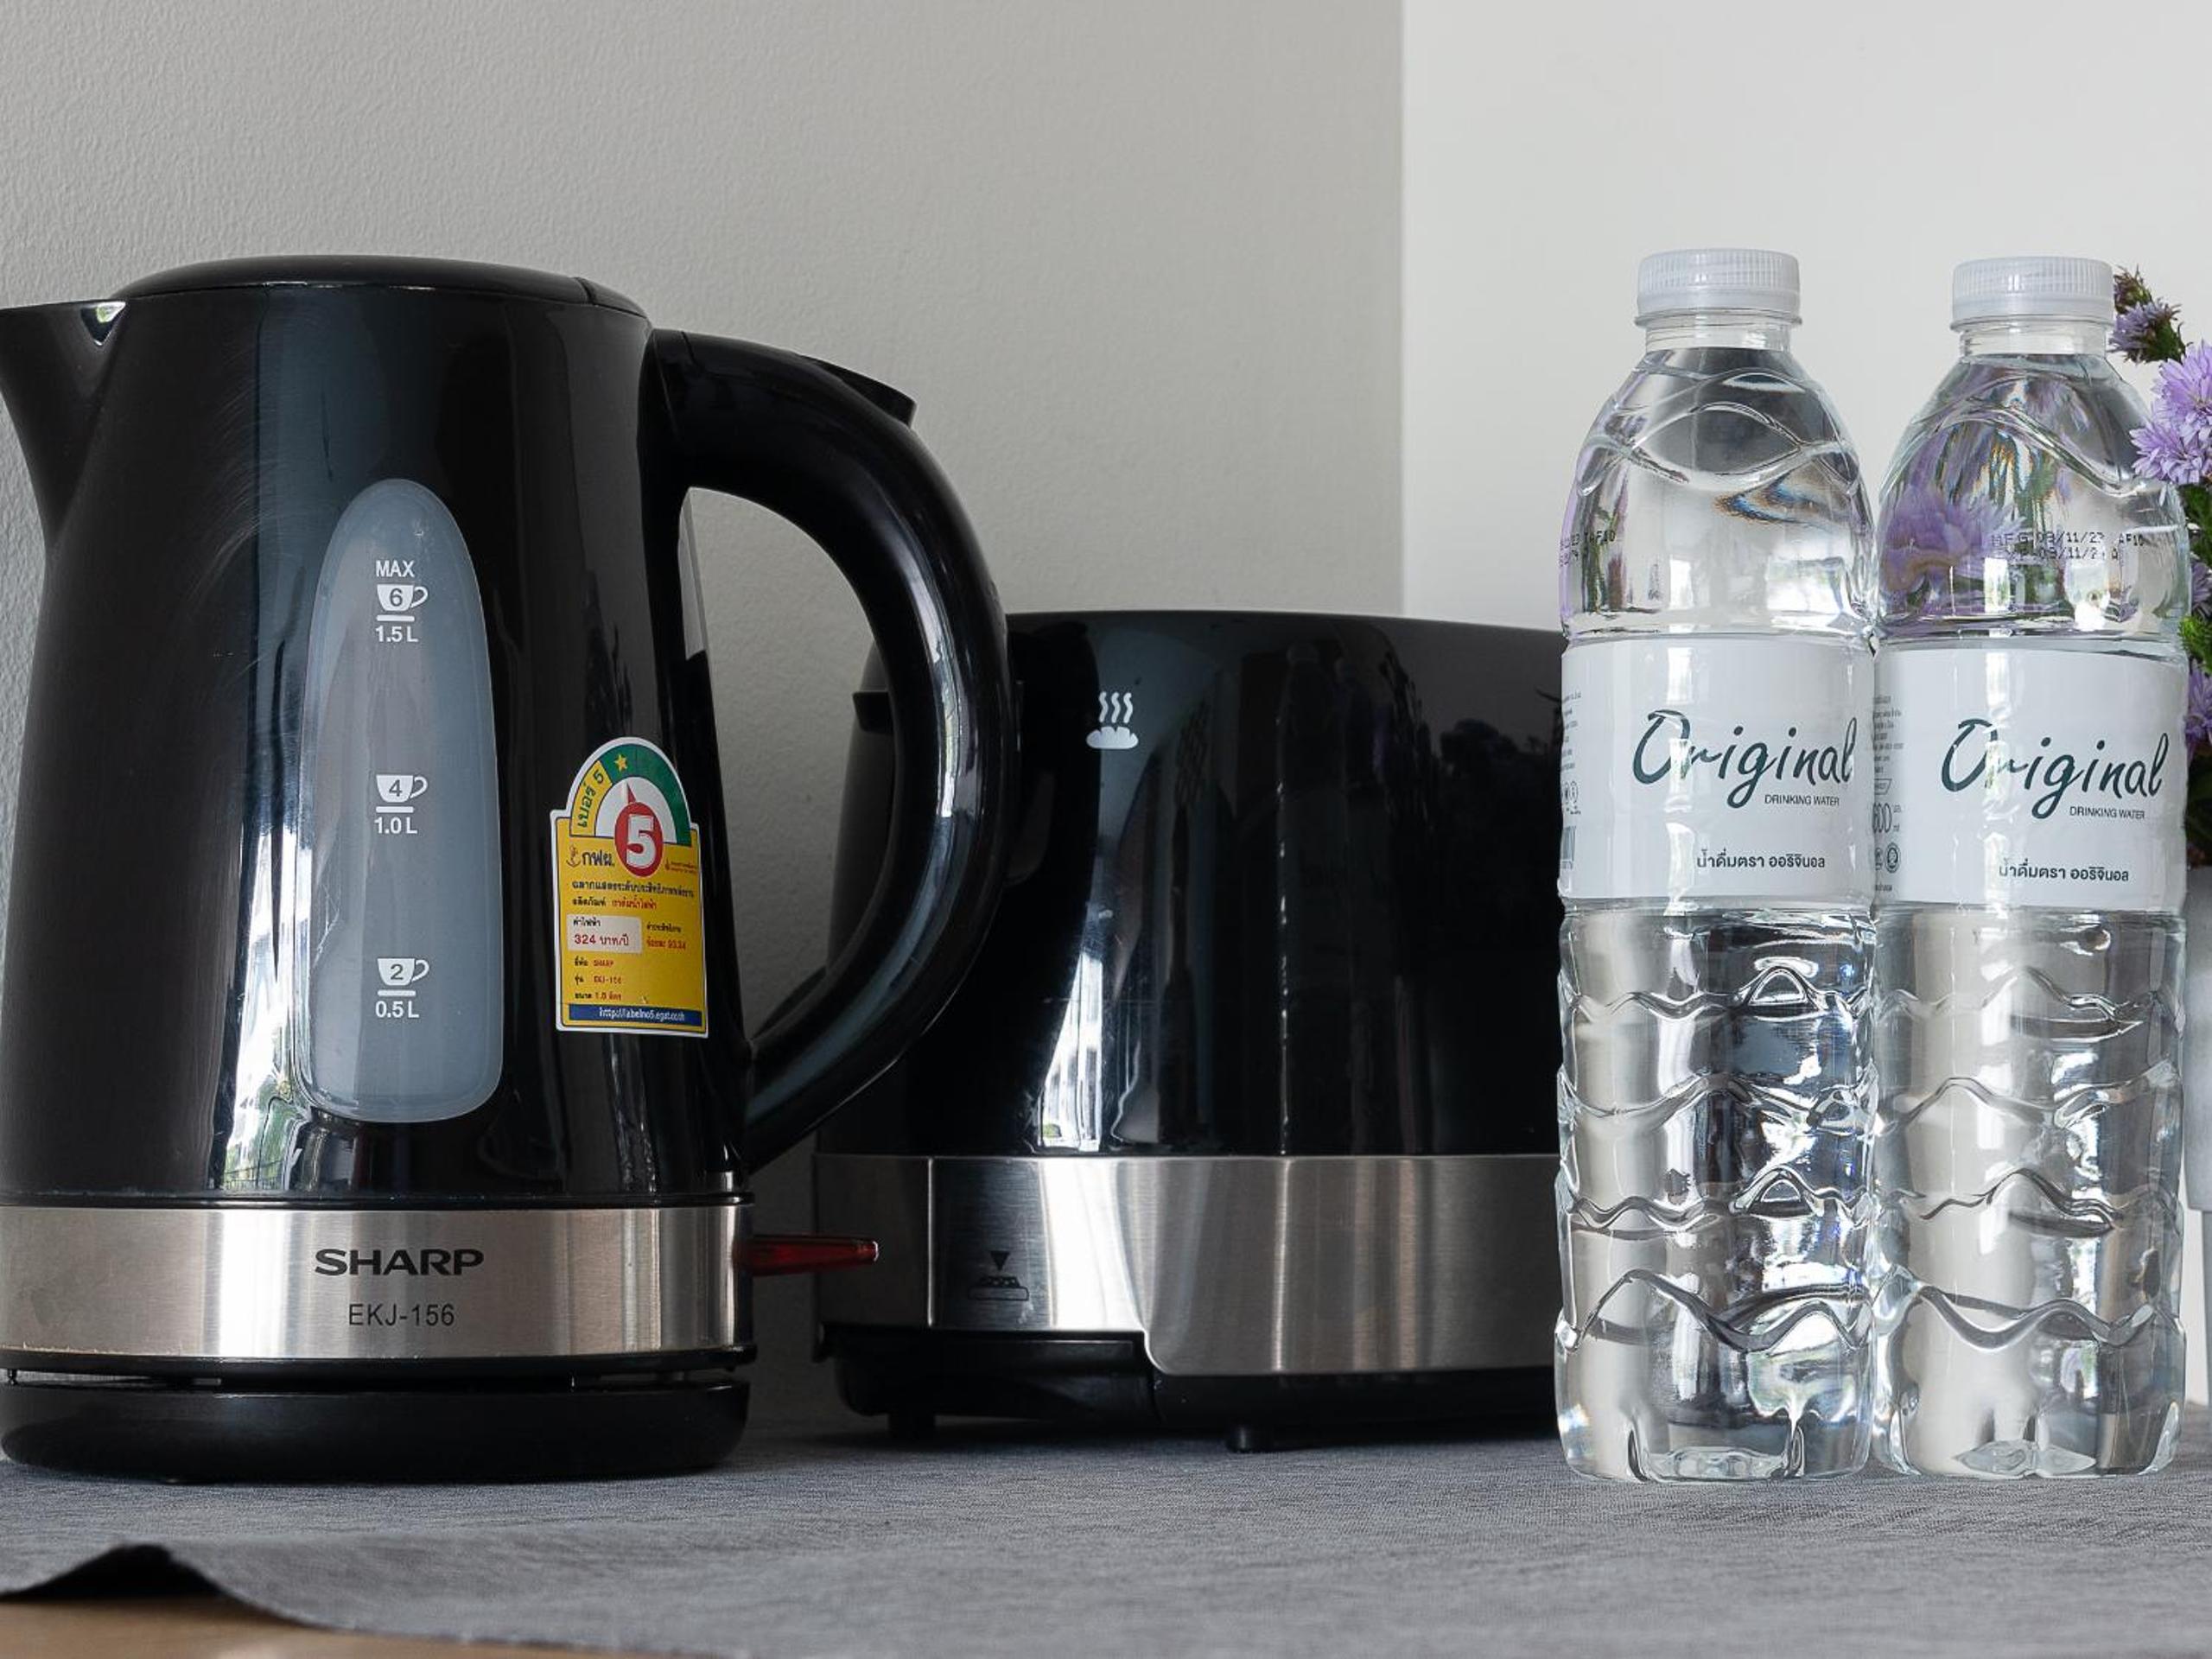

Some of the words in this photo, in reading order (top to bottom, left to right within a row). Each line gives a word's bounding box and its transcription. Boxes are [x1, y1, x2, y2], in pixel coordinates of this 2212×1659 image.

[376, 560, 415, 577] MAX
[390, 588, 403, 607] 6
[375, 626, 403, 642] 1.5
[407, 626, 418, 642] L
[1632, 709, 1857, 809] Original
[1941, 718, 2169, 819] Original
[389, 779, 403, 797] 4
[1764, 794, 1811, 805] DRINKING
[1814, 796, 1840, 807] WATER
[2069, 806, 2117, 819] DRINKING
[2119, 808, 2145, 819] WATER
[374, 817, 402, 834] 1.0
[406, 817, 417, 834] L
[626, 813, 657, 869] 5
[575, 934, 596, 944] 324
[391, 963, 404, 980] 2
[375, 1001, 404, 1018] 0.5
[408, 1001, 419, 1018] L
[315, 1249, 484, 1275] SHARP
[349, 1303, 455, 1326] EKJ-156
